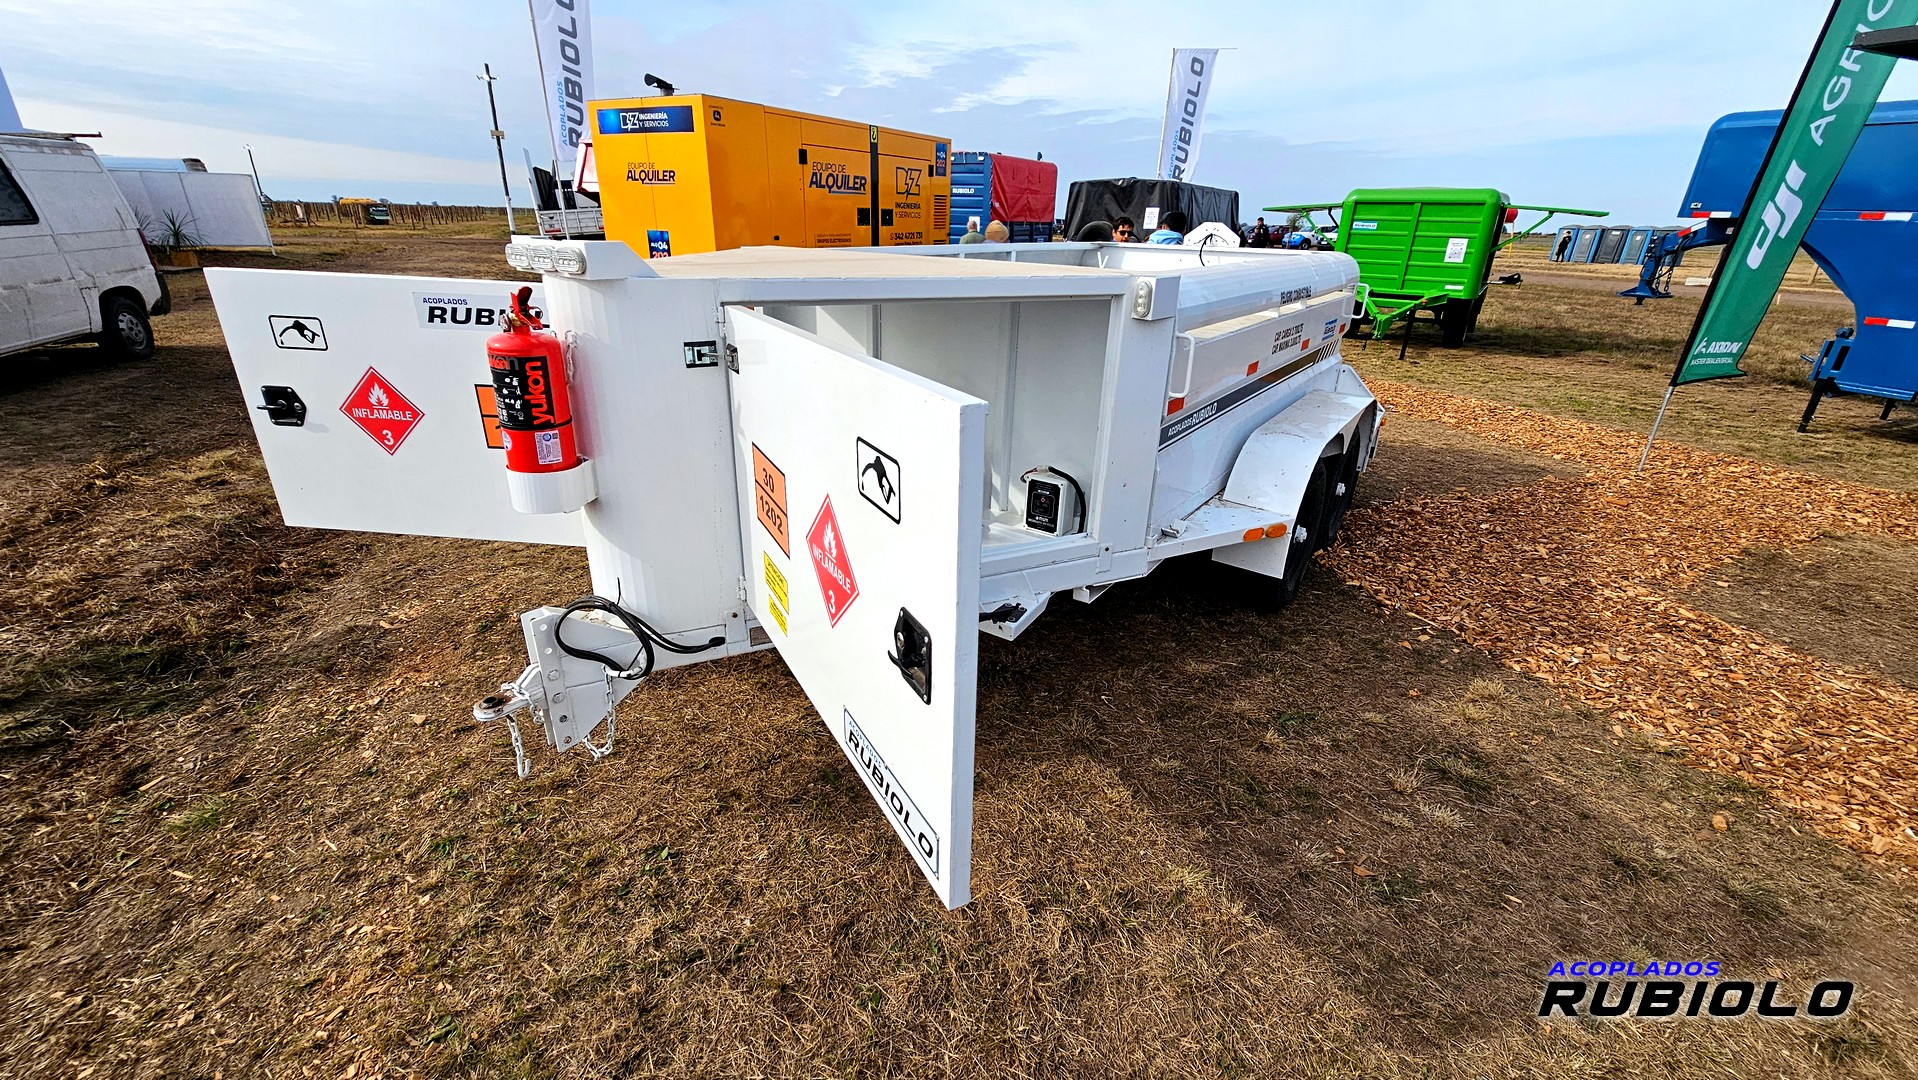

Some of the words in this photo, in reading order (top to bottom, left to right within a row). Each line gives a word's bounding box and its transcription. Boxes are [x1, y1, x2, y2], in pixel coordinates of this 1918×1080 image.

[557, 81, 568, 146] ACOPLADOS
[639, 111, 668, 120] INGENIERÍA
[1172, 56, 1204, 182] RUBIOLO
[812, 161, 837, 174] EQUIPO
[838, 164, 846, 174] DE
[1168, 130, 1179, 179] ACOPLADOS
[626, 170, 675, 184] ALQUILER
[809, 172, 867, 193] ALQUILER
[895, 202, 921, 210] INGENIERÍA
[422, 297, 468, 306] ACOPLADOS
[525, 361, 555, 425] yukon
[352, 408, 413, 421] INFLAMABLE
[1167, 417, 1193, 437] ACOPLADOS
[1192, 402, 1218, 426] RUBIOLO
[382, 430, 394, 445] 3
[762, 467, 775, 494] 30
[759, 494, 783, 535] 1202
[812, 542, 851, 595] INFLAMABLE
[828, 590, 836, 613] 3
[848, 720, 882, 768] ACOPLADOS
[848, 730, 934, 859] RUBIOLO
